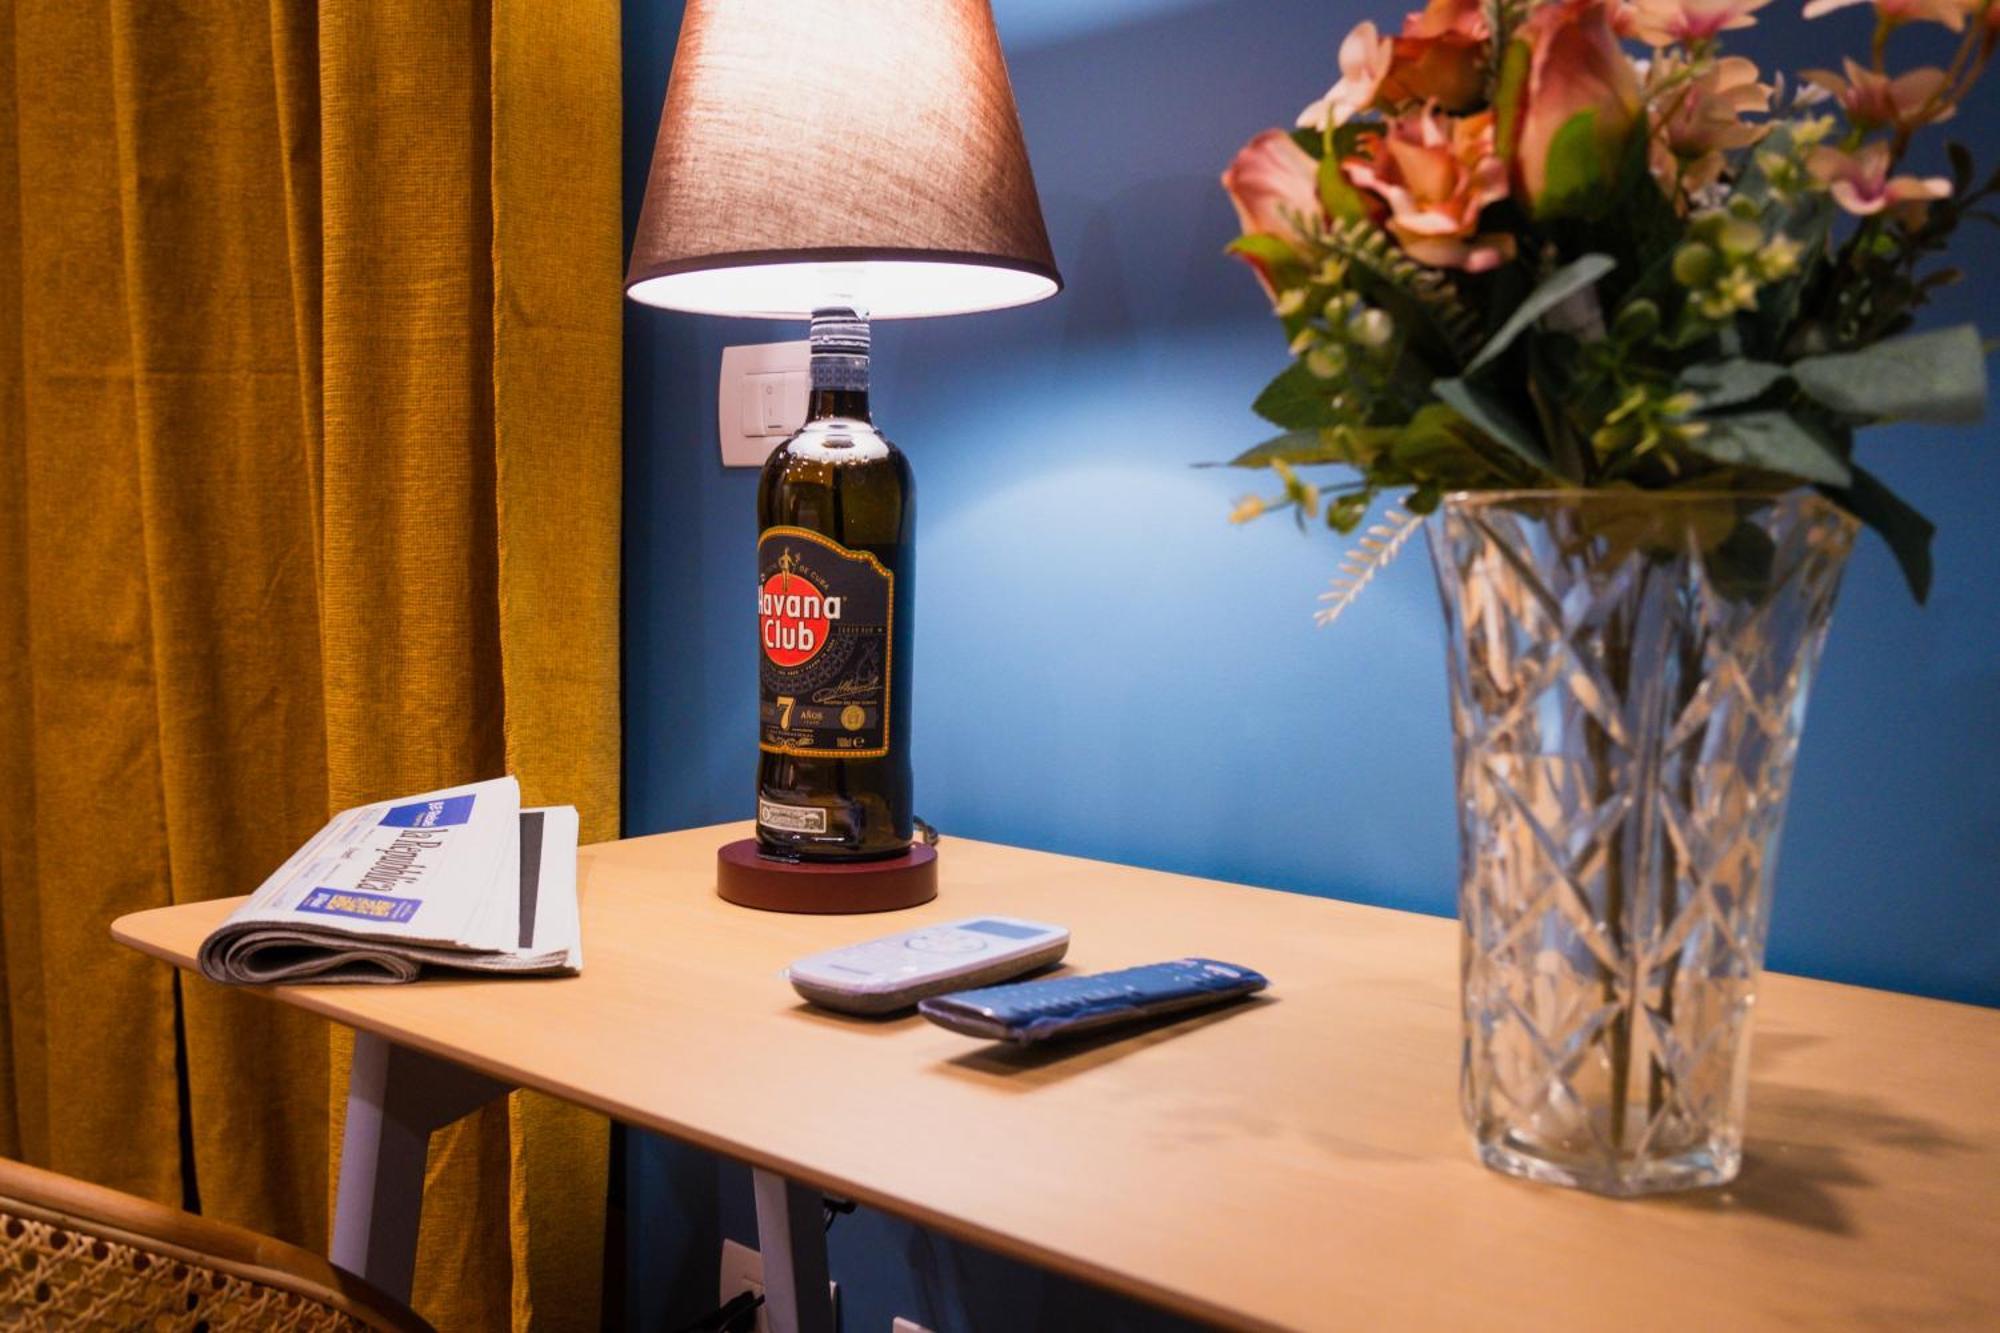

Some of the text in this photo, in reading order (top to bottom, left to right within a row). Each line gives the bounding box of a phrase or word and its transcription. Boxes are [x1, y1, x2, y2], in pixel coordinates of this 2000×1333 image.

[758, 584, 841, 620] Havana
[764, 619, 815, 651] Club
[776, 695, 796, 731] 7
[399, 828, 449, 839] la
[355, 839, 442, 892] Repubblica
